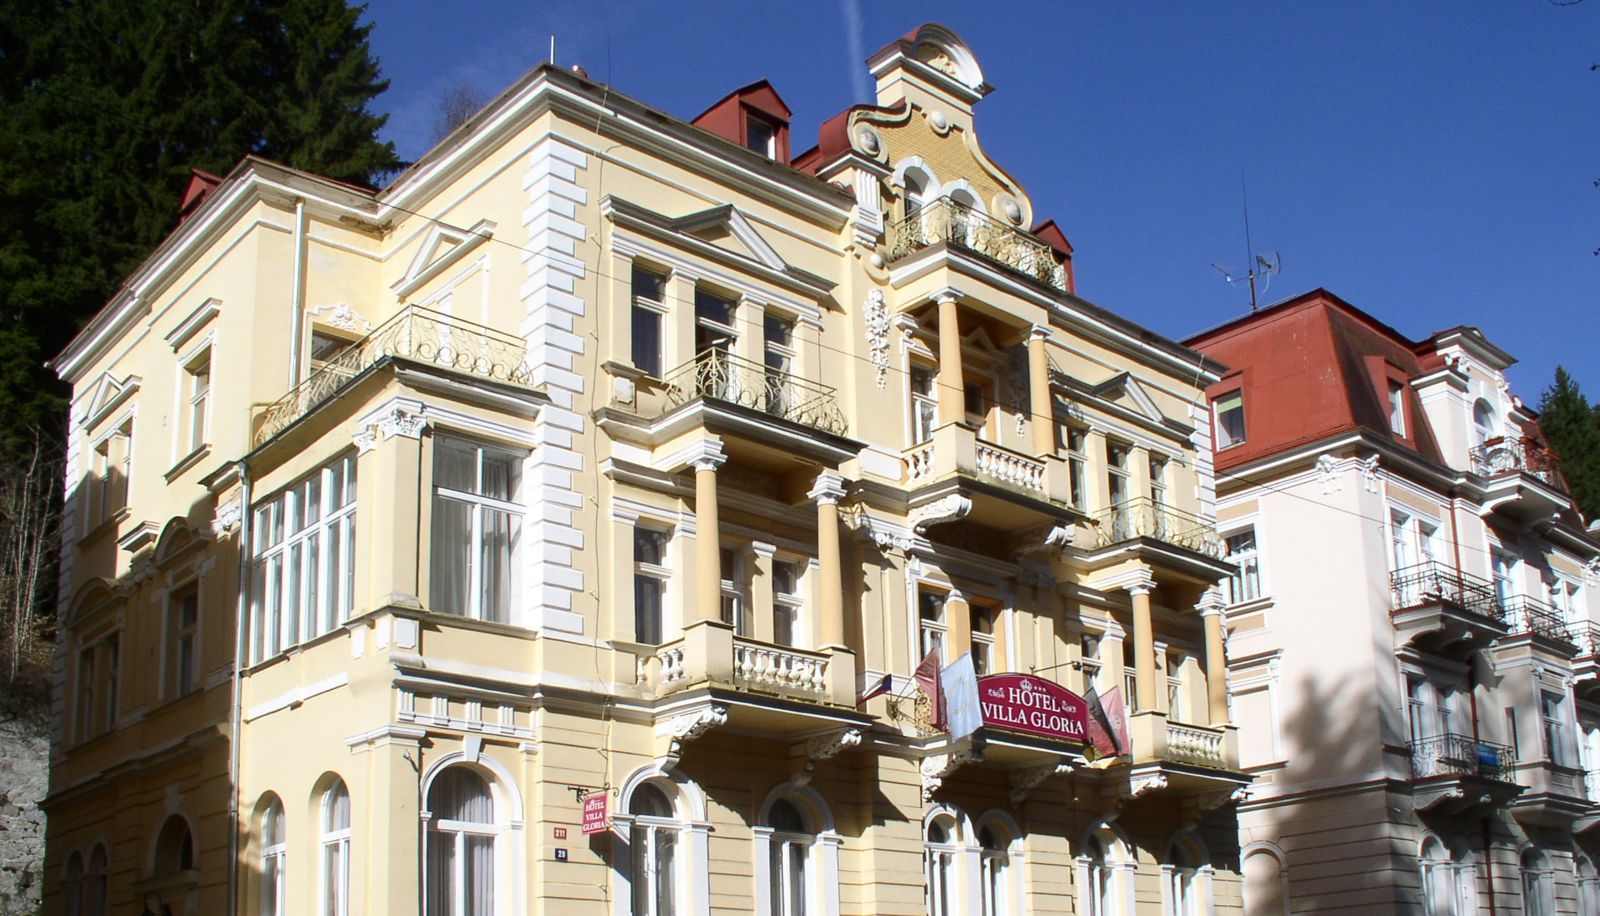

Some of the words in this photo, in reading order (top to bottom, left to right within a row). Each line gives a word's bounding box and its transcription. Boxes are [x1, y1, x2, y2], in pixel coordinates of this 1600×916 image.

[1008, 687, 1060, 712] HOTEL
[981, 702, 1027, 725] VILLA
[1030, 711, 1084, 734] GLORIA
[585, 801, 605, 811] HOTEL
[585, 811, 603, 821] VILLA
[583, 820, 605, 831] GLORIA
